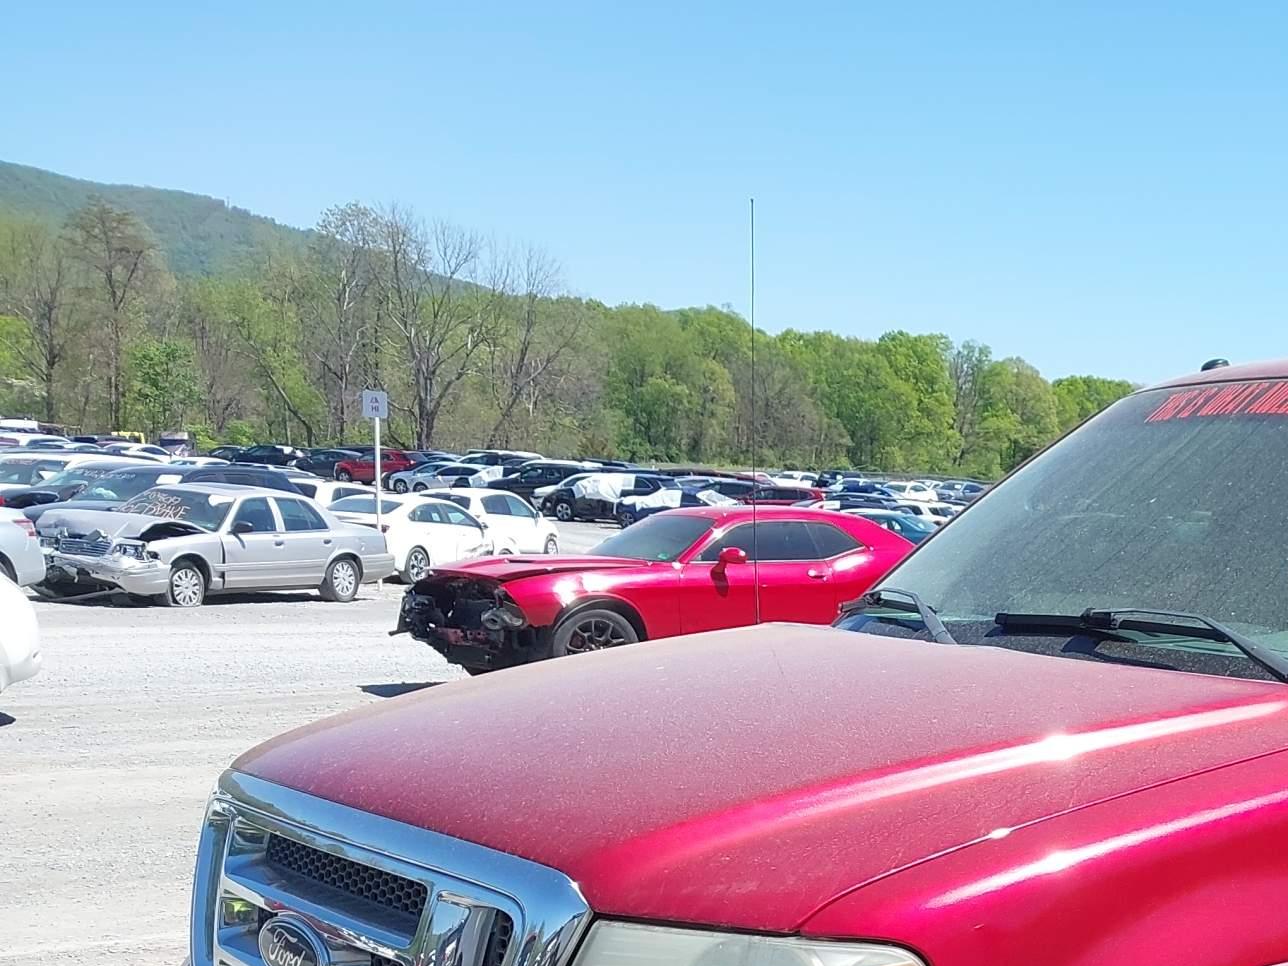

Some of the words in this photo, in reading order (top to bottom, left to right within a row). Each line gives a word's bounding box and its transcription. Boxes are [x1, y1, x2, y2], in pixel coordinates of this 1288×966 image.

[1144, 389, 1200, 423] THIS
[1177, 387, 1218, 418] IS
[1197, 382, 1270, 416] WHAT
